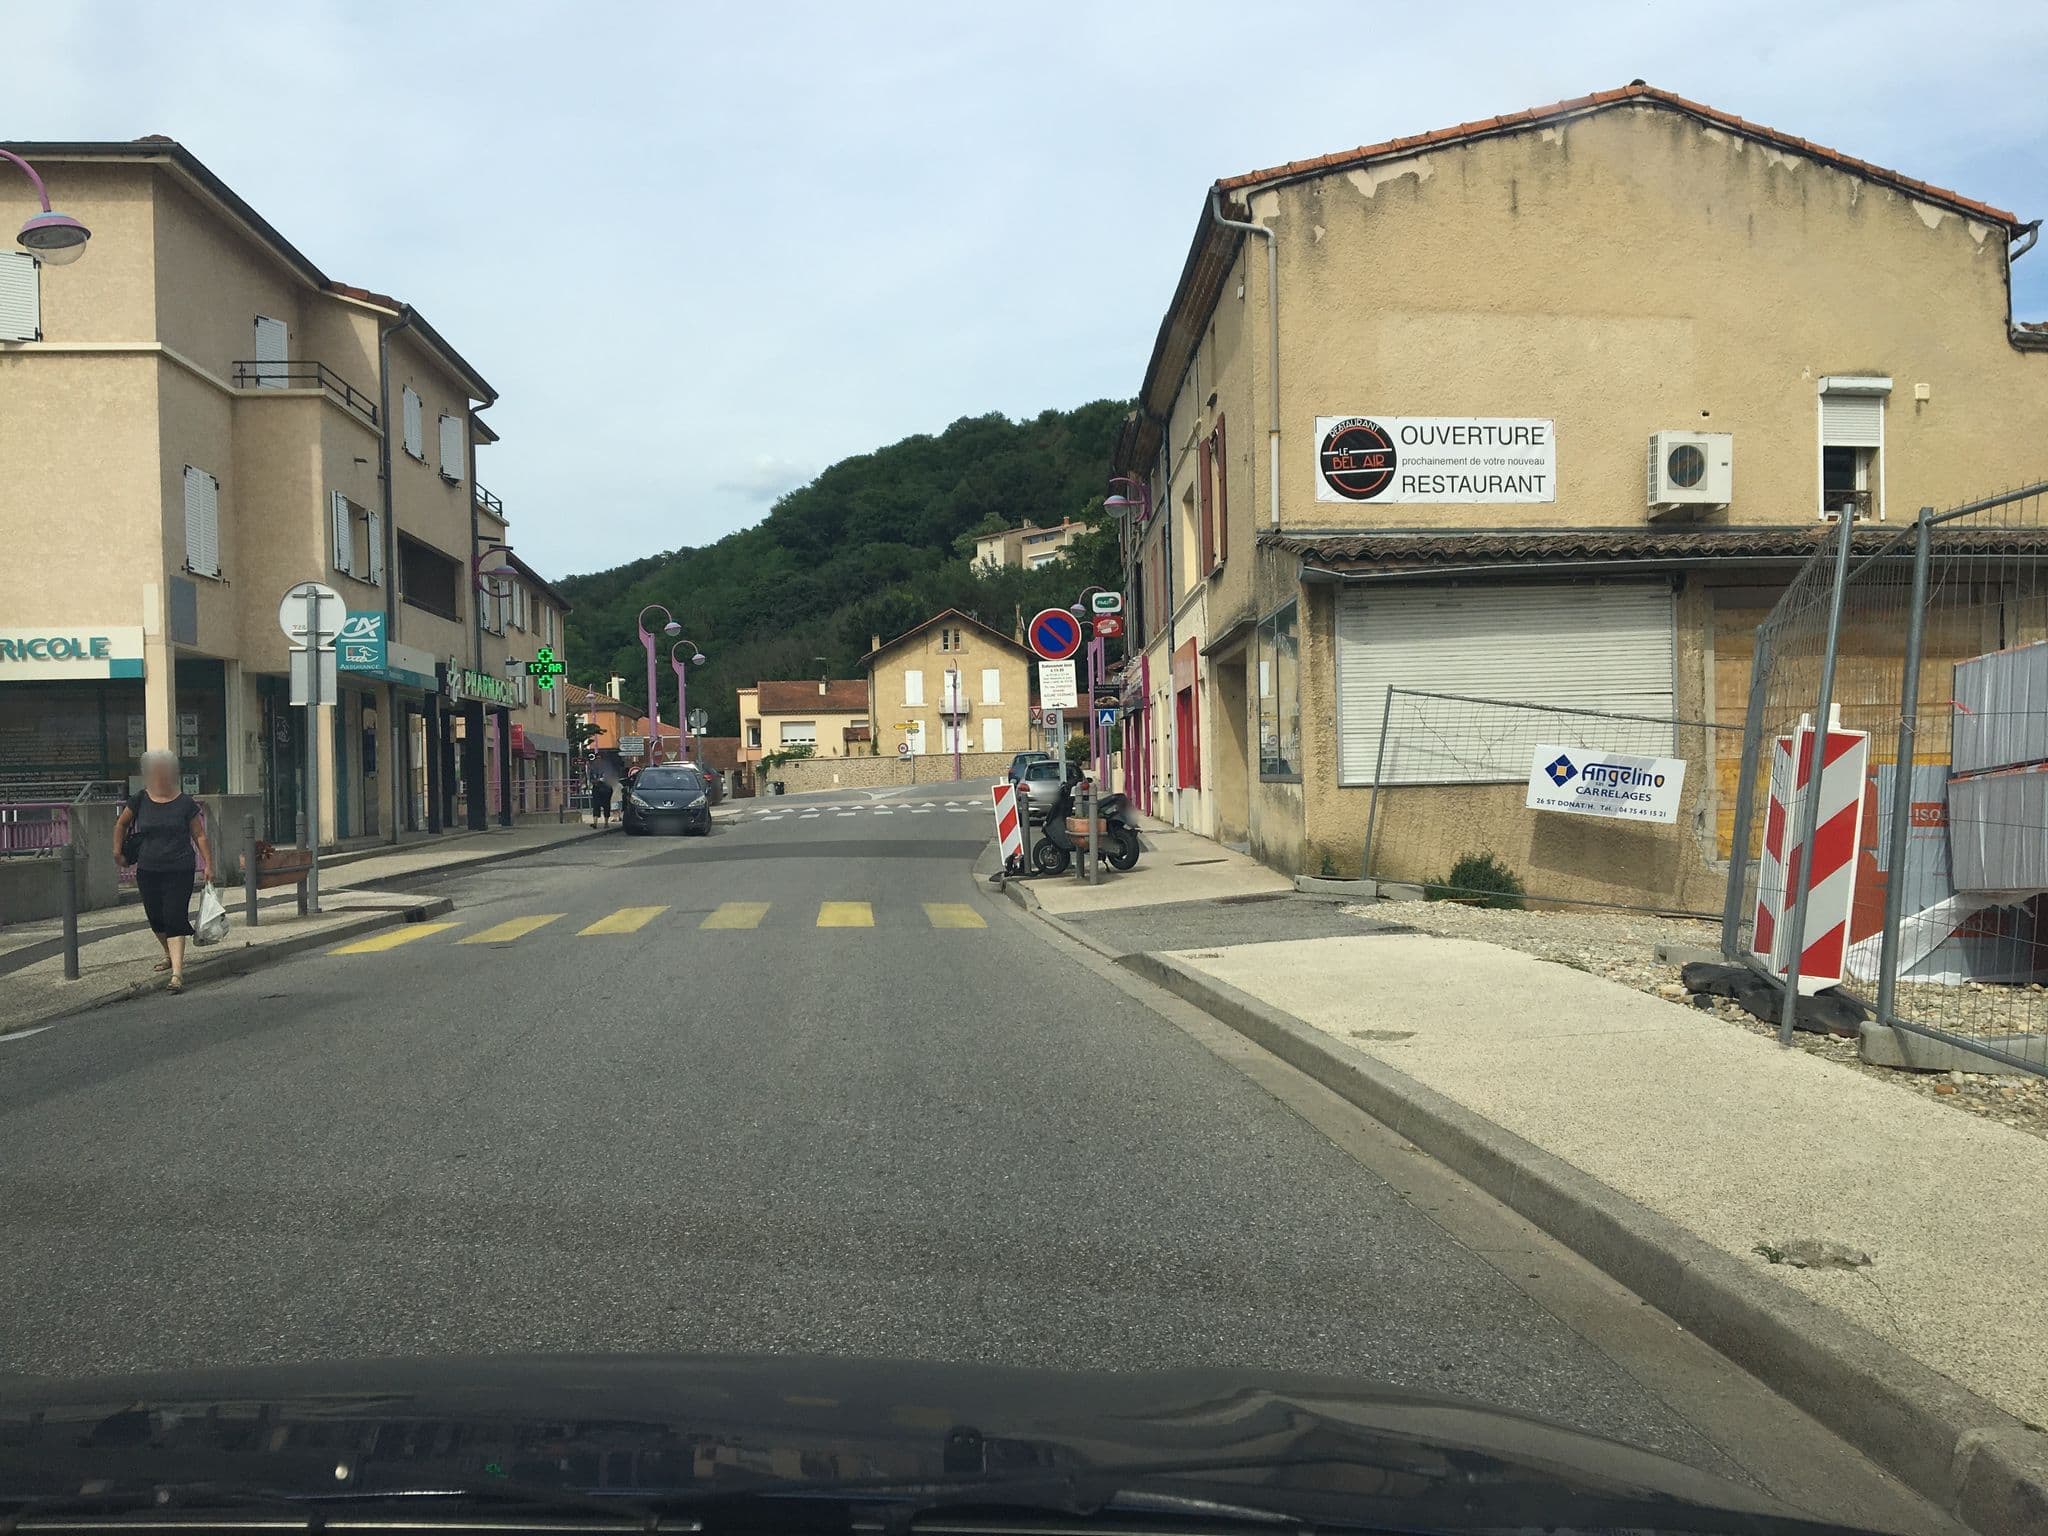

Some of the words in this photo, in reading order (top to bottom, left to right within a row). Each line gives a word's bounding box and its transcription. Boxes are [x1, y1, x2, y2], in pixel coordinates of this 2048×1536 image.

[1329, 418, 1380, 438] RESTAURANT
[1401, 426, 1545, 446] OUVERTURE
[1339, 447, 1349, 456] LE
[1332, 456, 1356, 470] BEL
[1363, 454, 1385, 468] AIR
[1402, 456, 1467, 467] prochainement
[1470, 456, 1481, 466] de
[1483, 457, 1505, 466] votre
[1508, 458, 1545, 466] nouveau
[1402, 475, 1546, 494] RESTAURANT
[465, 671, 513, 704] PHARMACIE
[1582, 763, 1665, 788] Angelino
[1576, 786, 1652, 802] CARRELAGES
